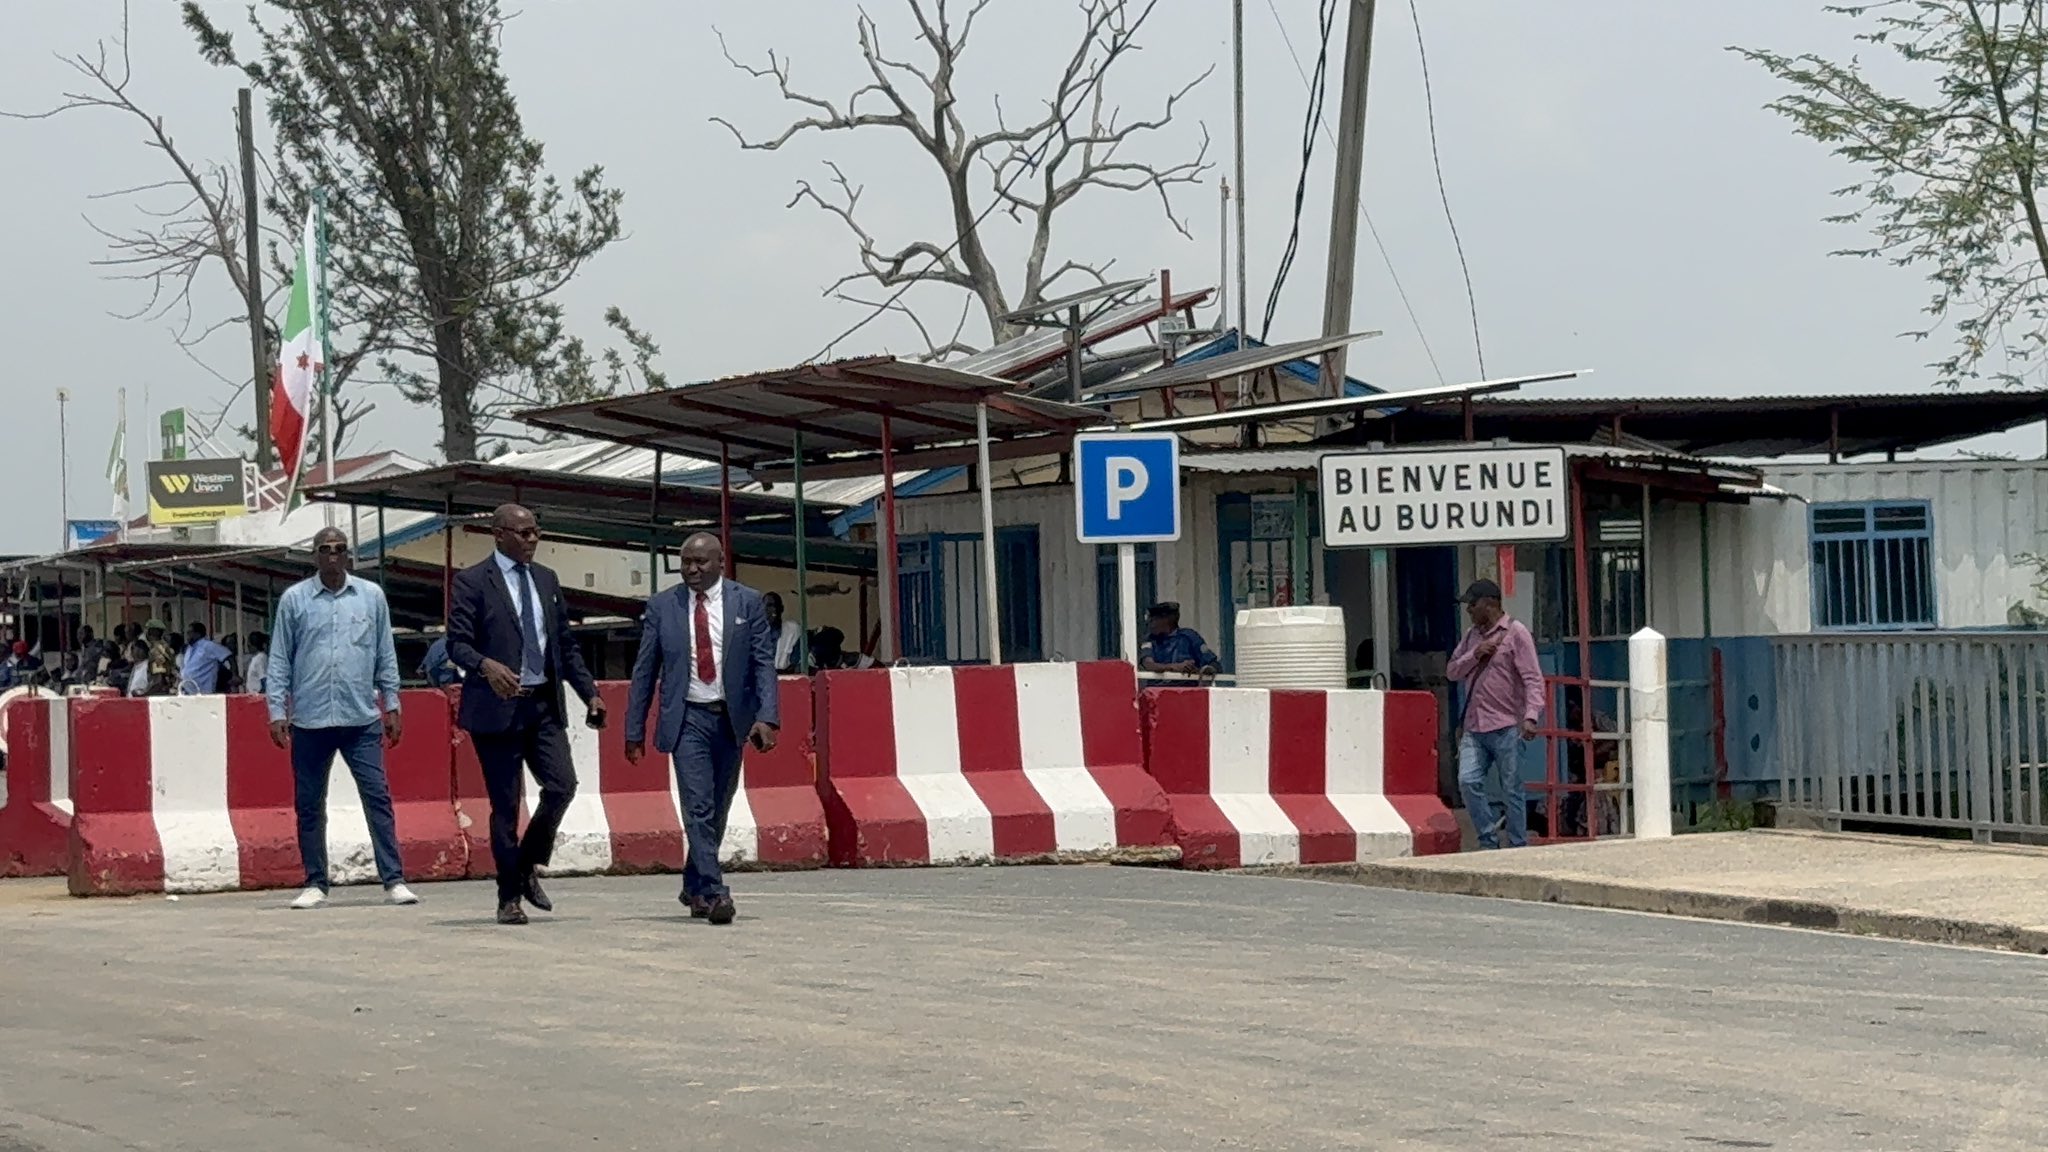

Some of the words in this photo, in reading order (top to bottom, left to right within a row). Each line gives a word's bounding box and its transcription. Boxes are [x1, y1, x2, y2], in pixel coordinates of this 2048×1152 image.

[192, 482, 224, 494] Union
[1105, 456, 1149, 521] P
[1335, 461, 1552, 496] BIENVENUE
[1338, 505, 1381, 533] AU
[1396, 499, 1553, 531] BURUNDI
